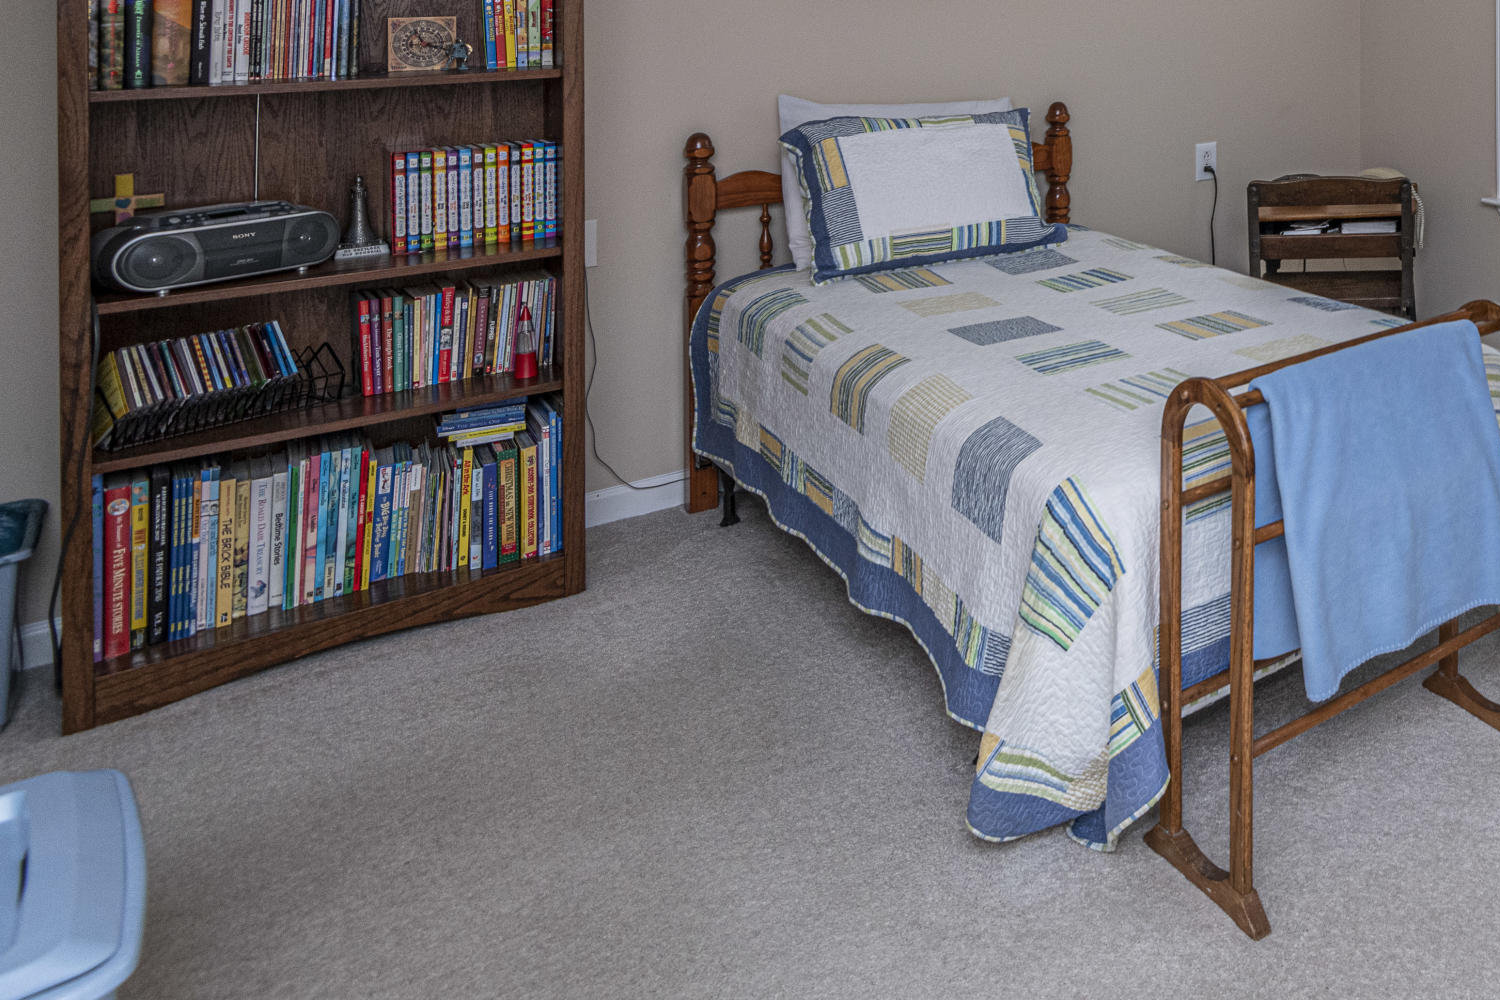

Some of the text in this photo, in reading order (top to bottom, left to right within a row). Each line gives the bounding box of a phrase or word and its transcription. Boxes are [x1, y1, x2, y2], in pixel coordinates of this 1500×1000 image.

[340, 479, 348, 509] Pocahontas
[504, 461, 513, 499] CHRISTMAS
[380, 502, 390, 516] BIG
[505, 507, 513, 523] NEW
[256, 483, 267, 575] THE ROALD DAHL TREASURY
[273, 513, 283, 566] Bedtime Stories
[506, 524, 514, 542] YORK
[113, 548, 125, 568] FIVE
[220, 518, 232, 589] THE BRICK BIBLE
[112, 569, 126, 602] MINUTE
[112, 602, 123, 634] STORIES
